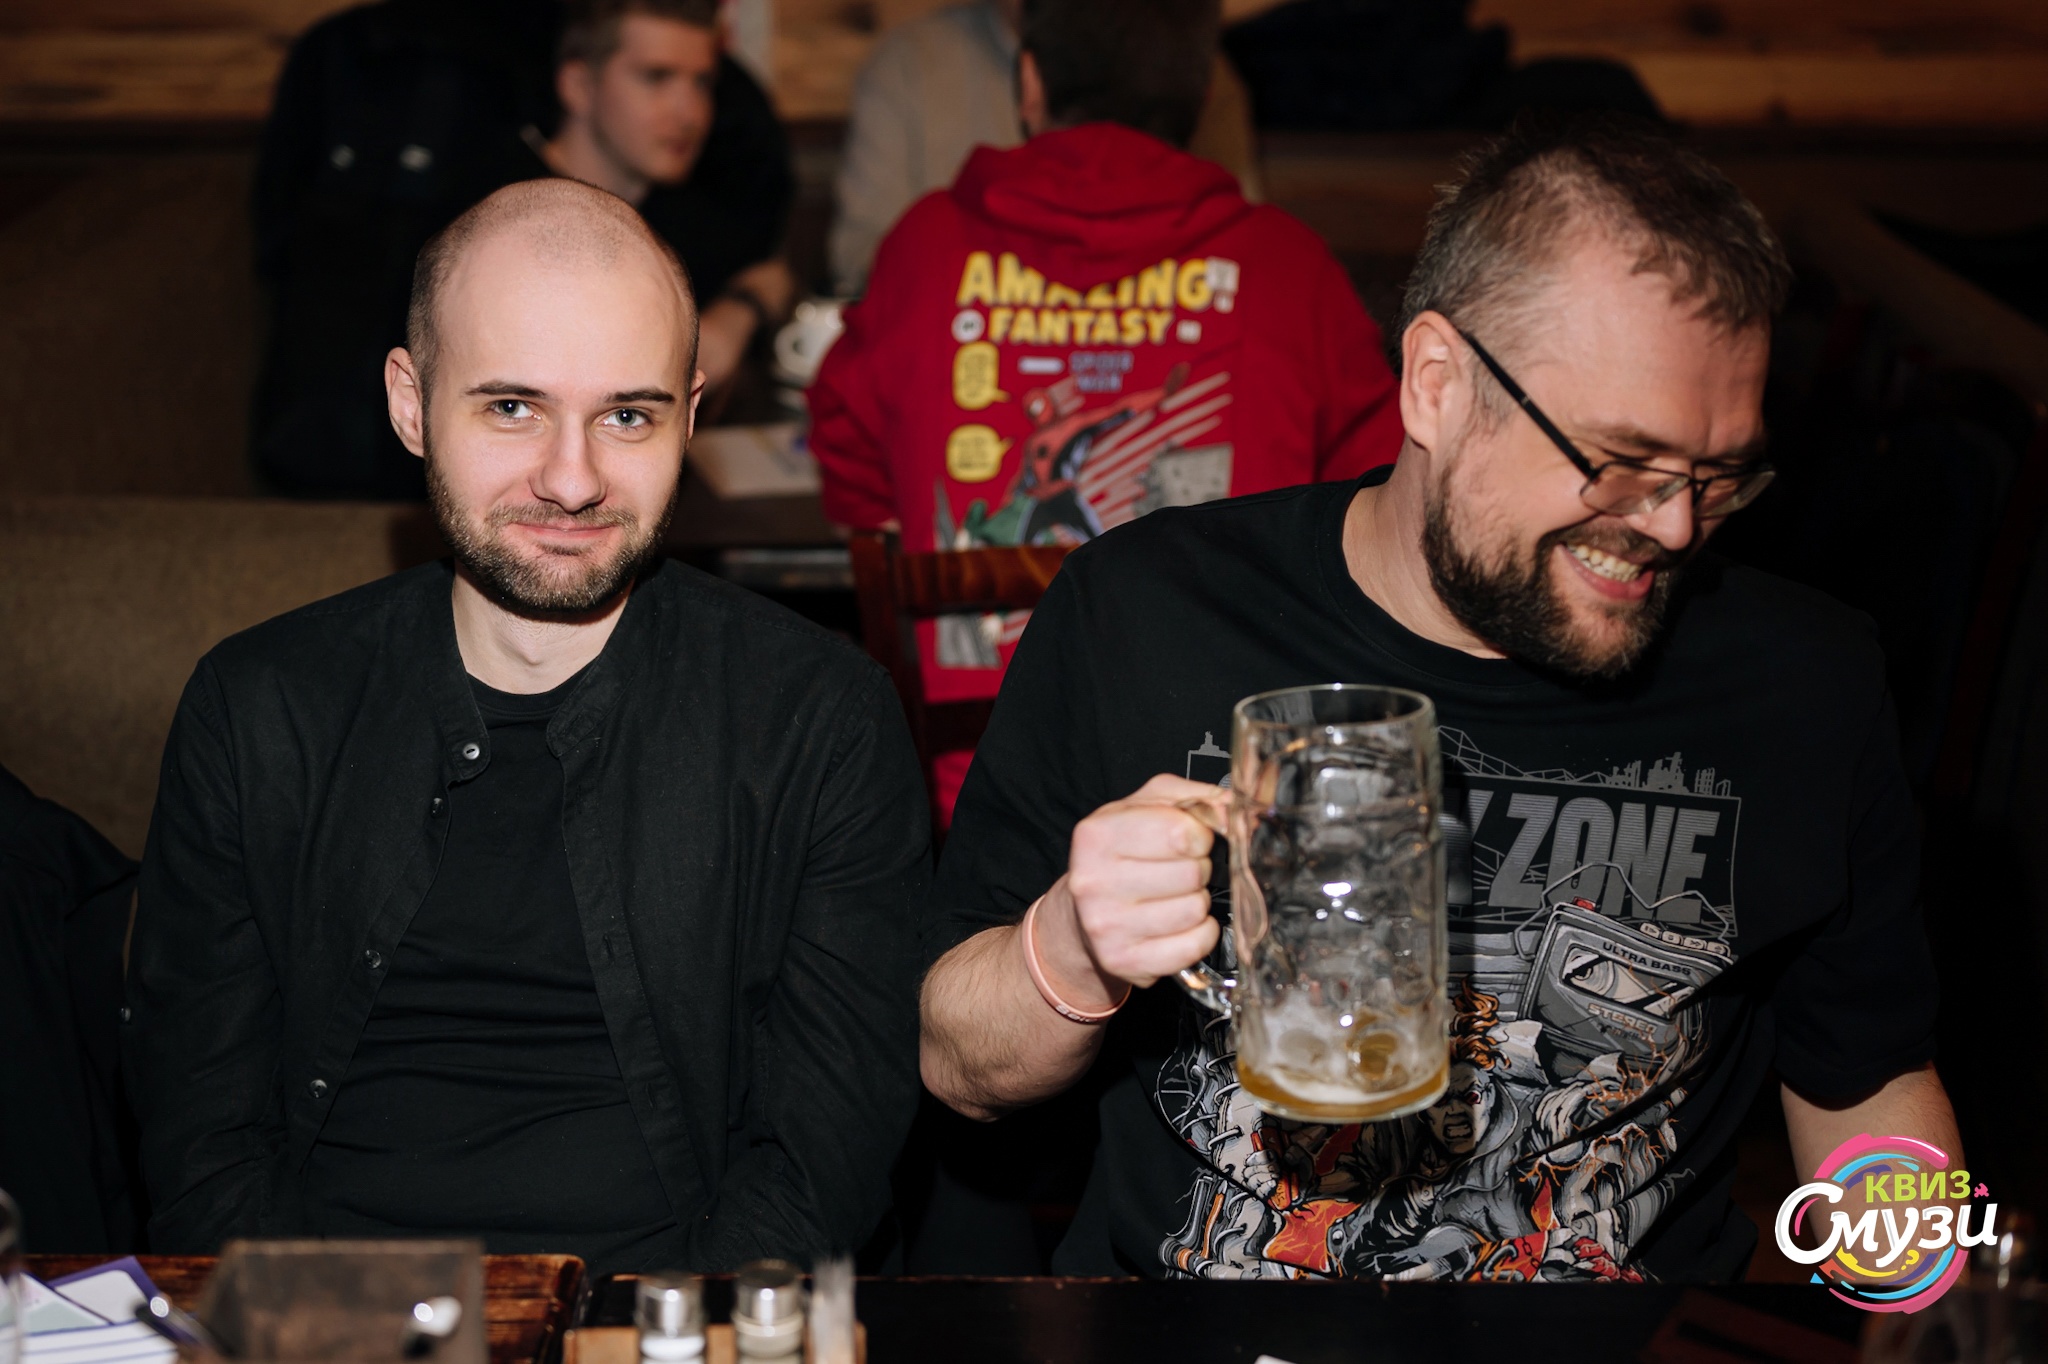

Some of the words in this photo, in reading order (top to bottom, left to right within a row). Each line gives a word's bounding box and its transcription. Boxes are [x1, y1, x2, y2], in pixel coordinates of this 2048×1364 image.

[988, 307, 1173, 345] FANTASY
[1488, 793, 1720, 923] ZONE
[1602, 941, 1647, 966] ULTRA
[1651, 959, 1692, 976] BASS
